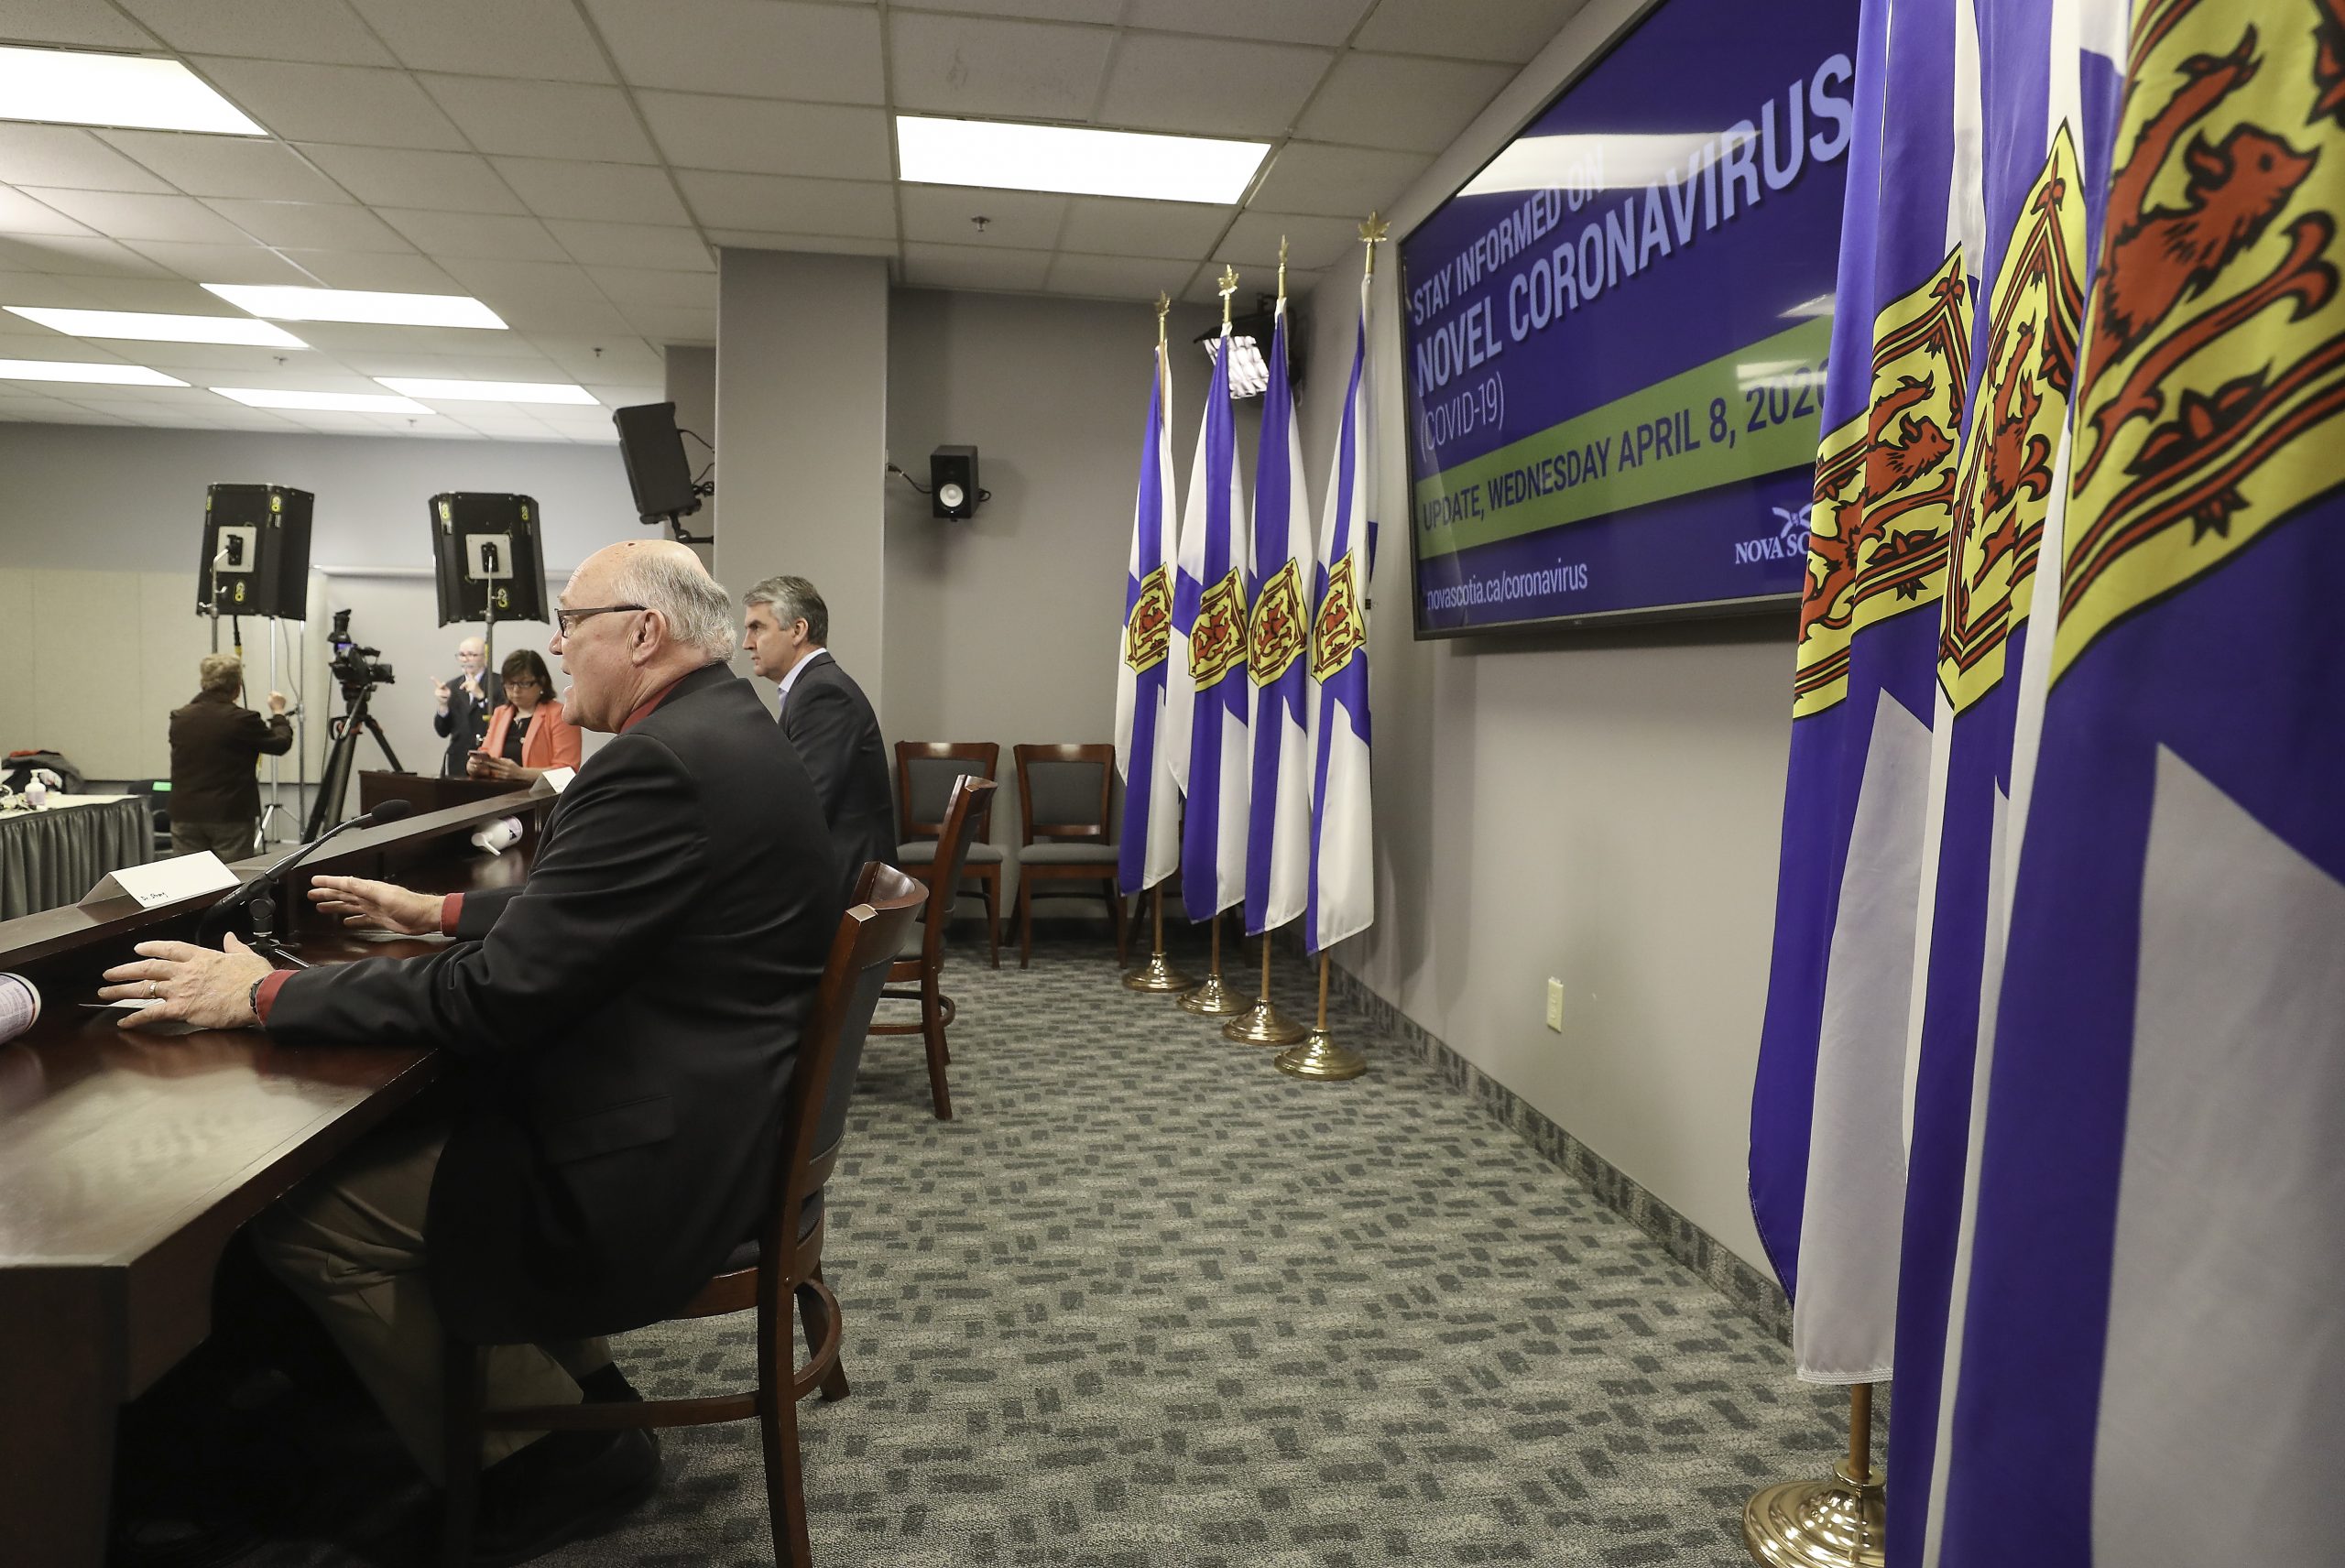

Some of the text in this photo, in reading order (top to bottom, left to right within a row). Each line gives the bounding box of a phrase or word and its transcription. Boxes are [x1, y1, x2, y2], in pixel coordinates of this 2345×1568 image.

[1413, 141, 1604, 325] STAY INFORMED ON
[1416, 53, 1853, 397] NOVEL CORONAVIRUS
[1421, 370, 1504, 463] (COVID-19)
[1423, 484, 1484, 531] UPDATE,
[1489, 437, 1611, 511] WEDNESDAY
[1618, 408, 1701, 473] APRIL
[1709, 397, 1736, 449] 8,
[1427, 557, 1588, 611] novascotia.ca/coronavirus
[1735, 536, 1784, 564] NOVA
